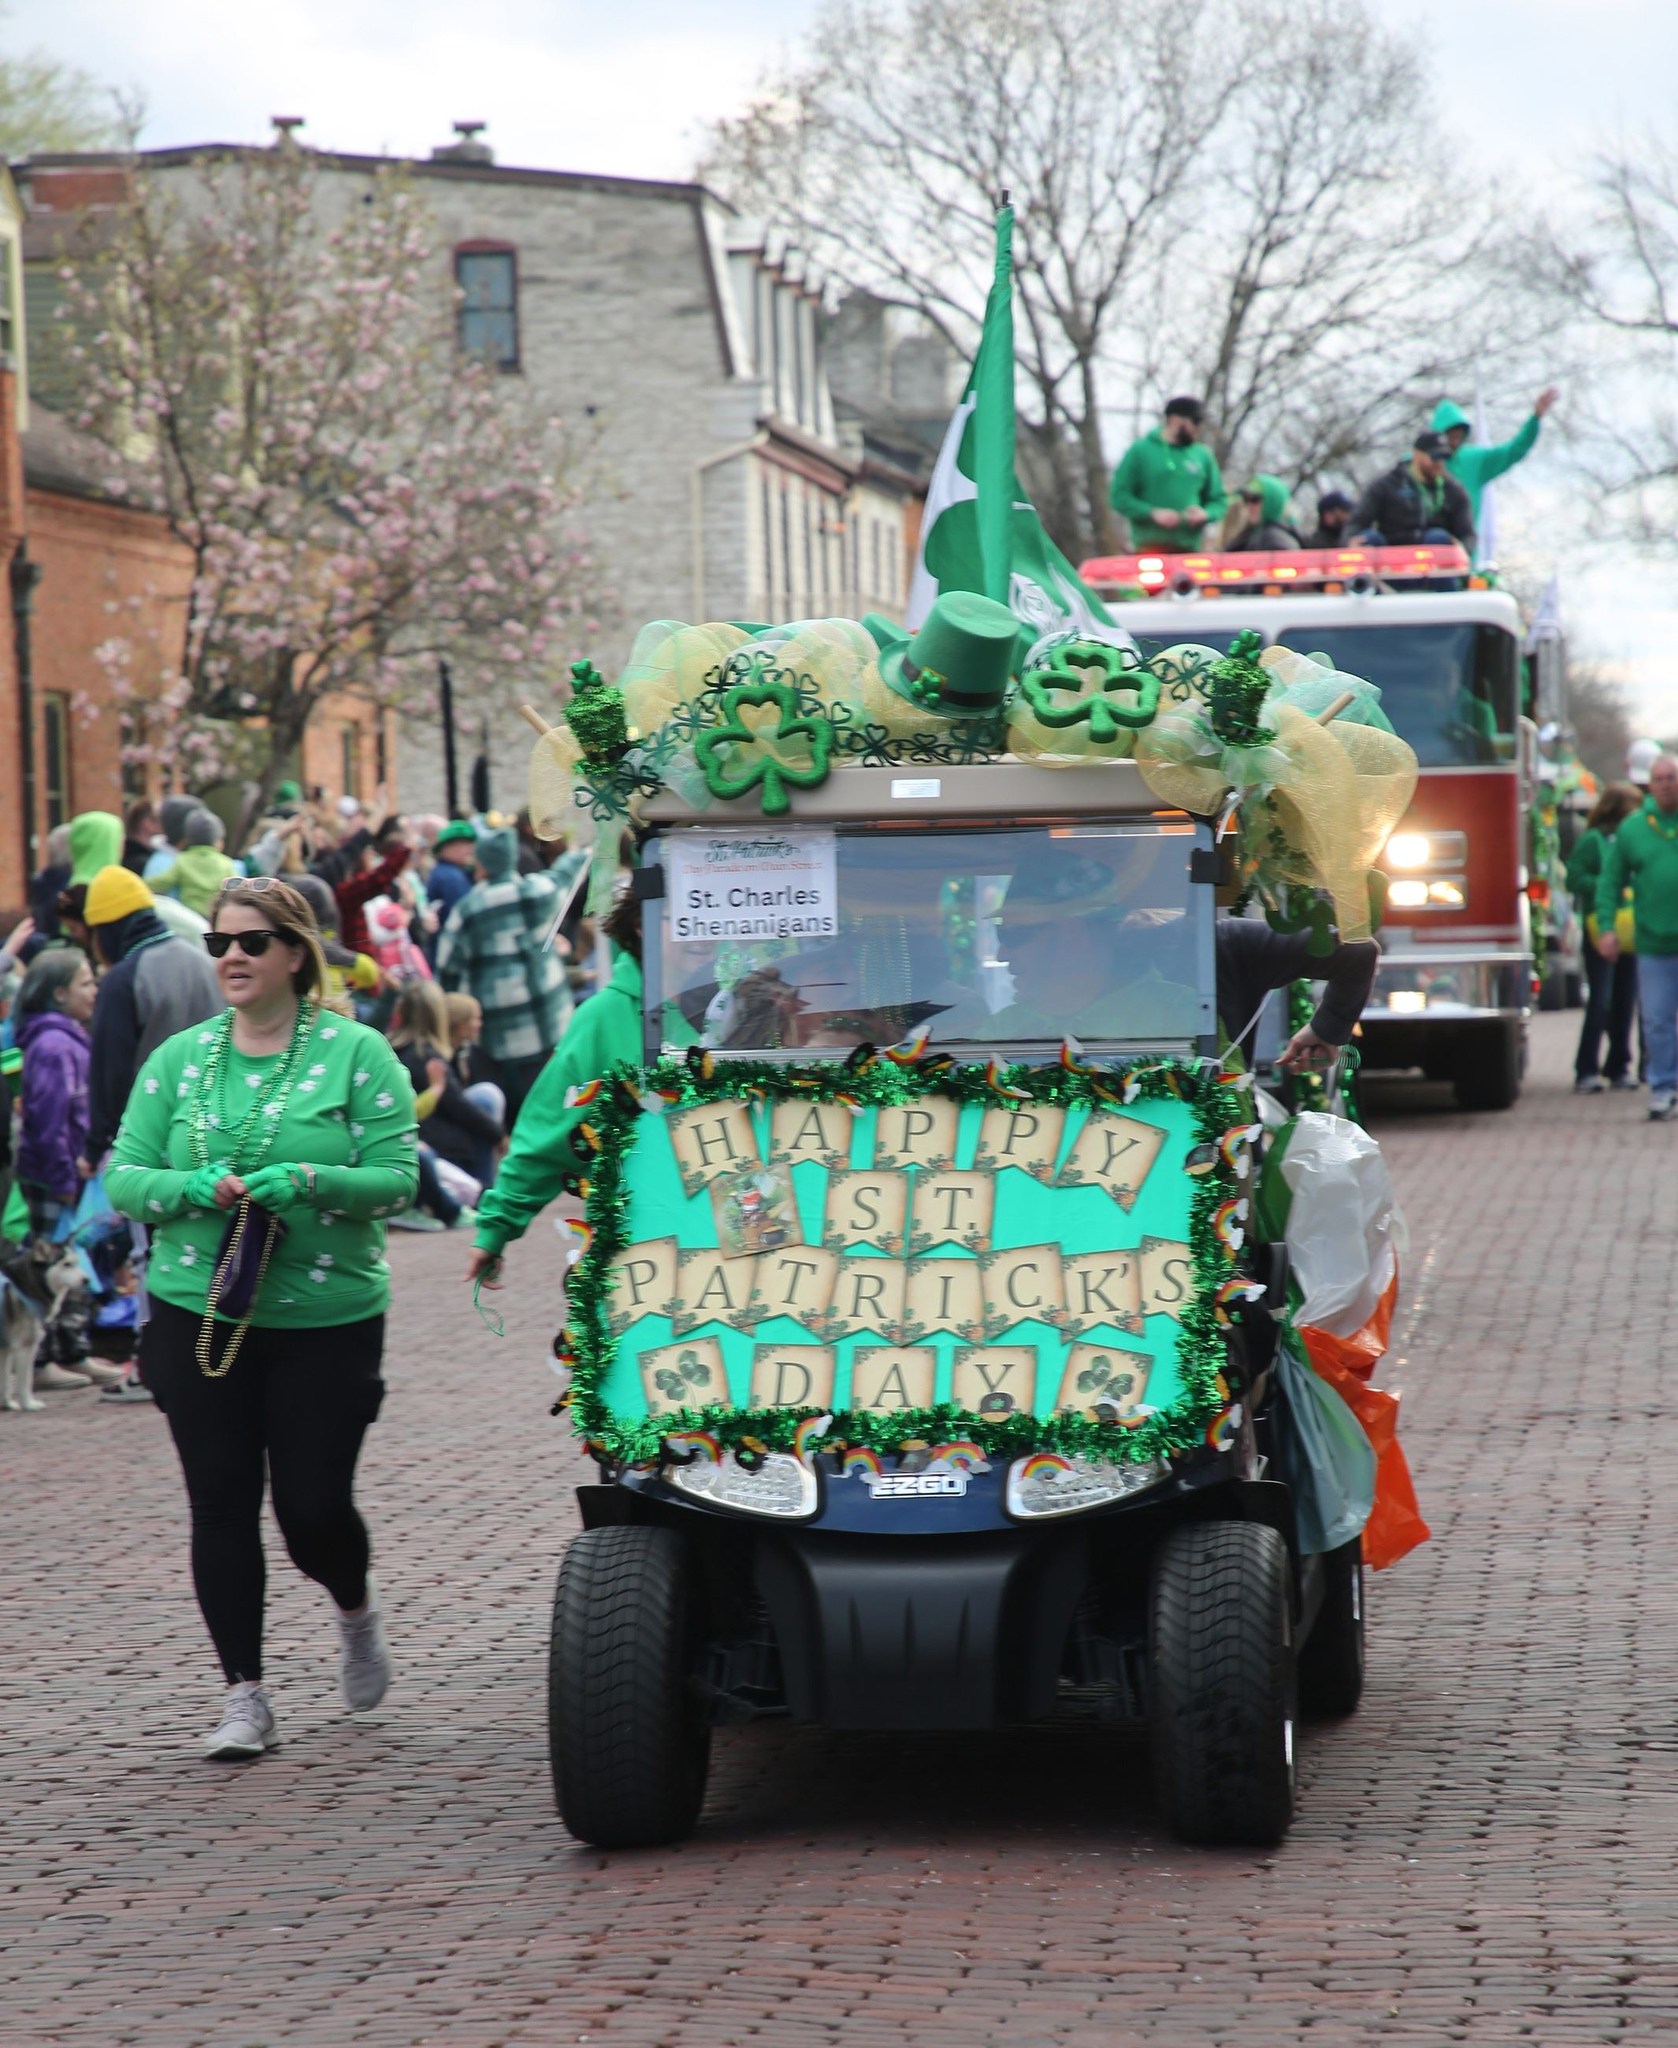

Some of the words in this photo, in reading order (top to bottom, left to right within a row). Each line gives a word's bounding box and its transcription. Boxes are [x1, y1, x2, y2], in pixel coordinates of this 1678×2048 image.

[688, 889, 720, 909] St.
[727, 885, 821, 908] Charles
[677, 913, 833, 938] Shenanigans
[690, 1106, 1142, 1178] HAPPY
[622, 1258, 1191, 1319] PATRICK'S
[771, 1361, 1016, 1410] DAY
